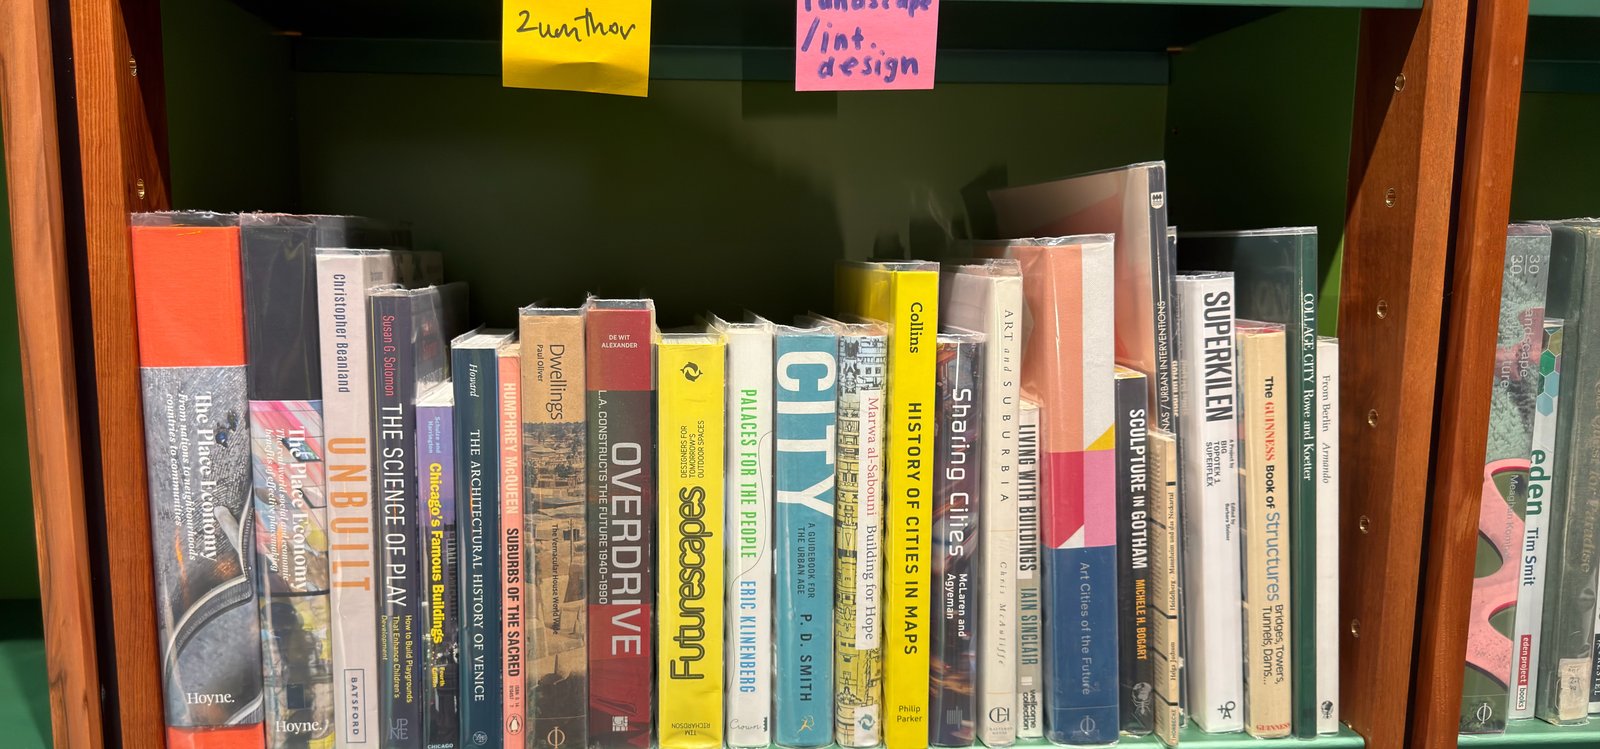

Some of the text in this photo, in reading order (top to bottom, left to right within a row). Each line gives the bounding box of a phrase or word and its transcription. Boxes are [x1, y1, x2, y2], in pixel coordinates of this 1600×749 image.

[817, 48, 919, 83] design
[333, 274, 350, 393] Christopher Beanland
[382, 315, 396, 396] Susan G. Solomon
[909, 301, 923, 354] Collins
[1158, 301, 1170, 402] URBAN INTERVENTIONS
[1203, 291, 1233, 423] SUPERKILEN
[469, 364, 479, 397] Howard
[546, 344, 567, 420] Dwellings
[1000, 309, 1014, 502] ART and SUBURBIA
[1303, 293, 1314, 481] COLLAGE CITY Rowe and Koetter
[680, 426, 688, 478] DESIGNERS FOR
[697, 421, 705, 447] SPACES
[776, 351, 836, 518] CITY
[1205, 441, 1213, 487] SUPERFLEX
[1213, 441, 1221, 476] TOPOTEK
[1220, 440, 1228, 454] BIG
[1322, 375, 1331, 484] From Berlin Armando
[195, 391, 219, 562] The Place Economy
[382, 403, 407, 607] THE SCIENCE OF PLAY
[598, 390, 608, 547] L.A. CONSTRUCTS THE FUTURE
[946, 388, 972, 556] Sharing Cities
[1264, 376, 1281, 602] The GUINNESS Book of Structures
[1526, 450, 1551, 516] eden
[288, 426, 309, 592] The Place Economy
[328, 437, 370, 592] UNBUILT
[504, 383, 520, 677] HUMPHREY McQUEEN SUBURBS OF THE SACRED
[740, 389, 758, 693] PALACES FOR THE PEOPLE ERIC KLINENBERG
[862, 397, 879, 640] Marwa al-Sabouni Building for Hope
[904, 402, 922, 655] HISTORY OF CITIES IN MAPS
[1018, 424, 1038, 665] LIVING WITH BUILDINGS IAIN SINCLAIR
[1129, 409, 1148, 660] SCULPTURE IN GOTHAM MICHELE H. BOGART
[431, 530, 443, 581] Famous
[470, 429, 484, 701] THE ARCHITECTURAL HISTORY OF VENICE
[611, 442, 642, 656] OVERDRIVE
[670, 487, 713, 679] Futurescapes
[797, 527, 805, 595] THE URBAN AGE
[807, 530, 815, 579] GUIDEBOOK
[1523, 527, 1539, 587] Tim Smit
[392, 615, 400, 631] That
[431, 584, 444, 644] Buildings
[945, 573, 956, 619] Agyeman
[958, 573, 967, 637] McLaren and
[996, 561, 1008, 665] Chris McAuliffe
[1079, 562, 1092, 695] Art Cities of the Future
[380, 615, 389, 661] Development
[405, 631, 412, 639] to
[800, 614, 812, 701] P. D. SMITH
[1519, 637, 1529, 684] eden project
[186, 692, 235, 704] Hoyne.
[350, 676, 360, 736] BATSFORD
[404, 660, 413, 703] Playgrounds
[898, 705, 921, 714] Philip
[1518, 687, 1527, 708] books
[730, 719, 761, 729] Crown
[1256, 722, 1291, 730] GUINNESS
